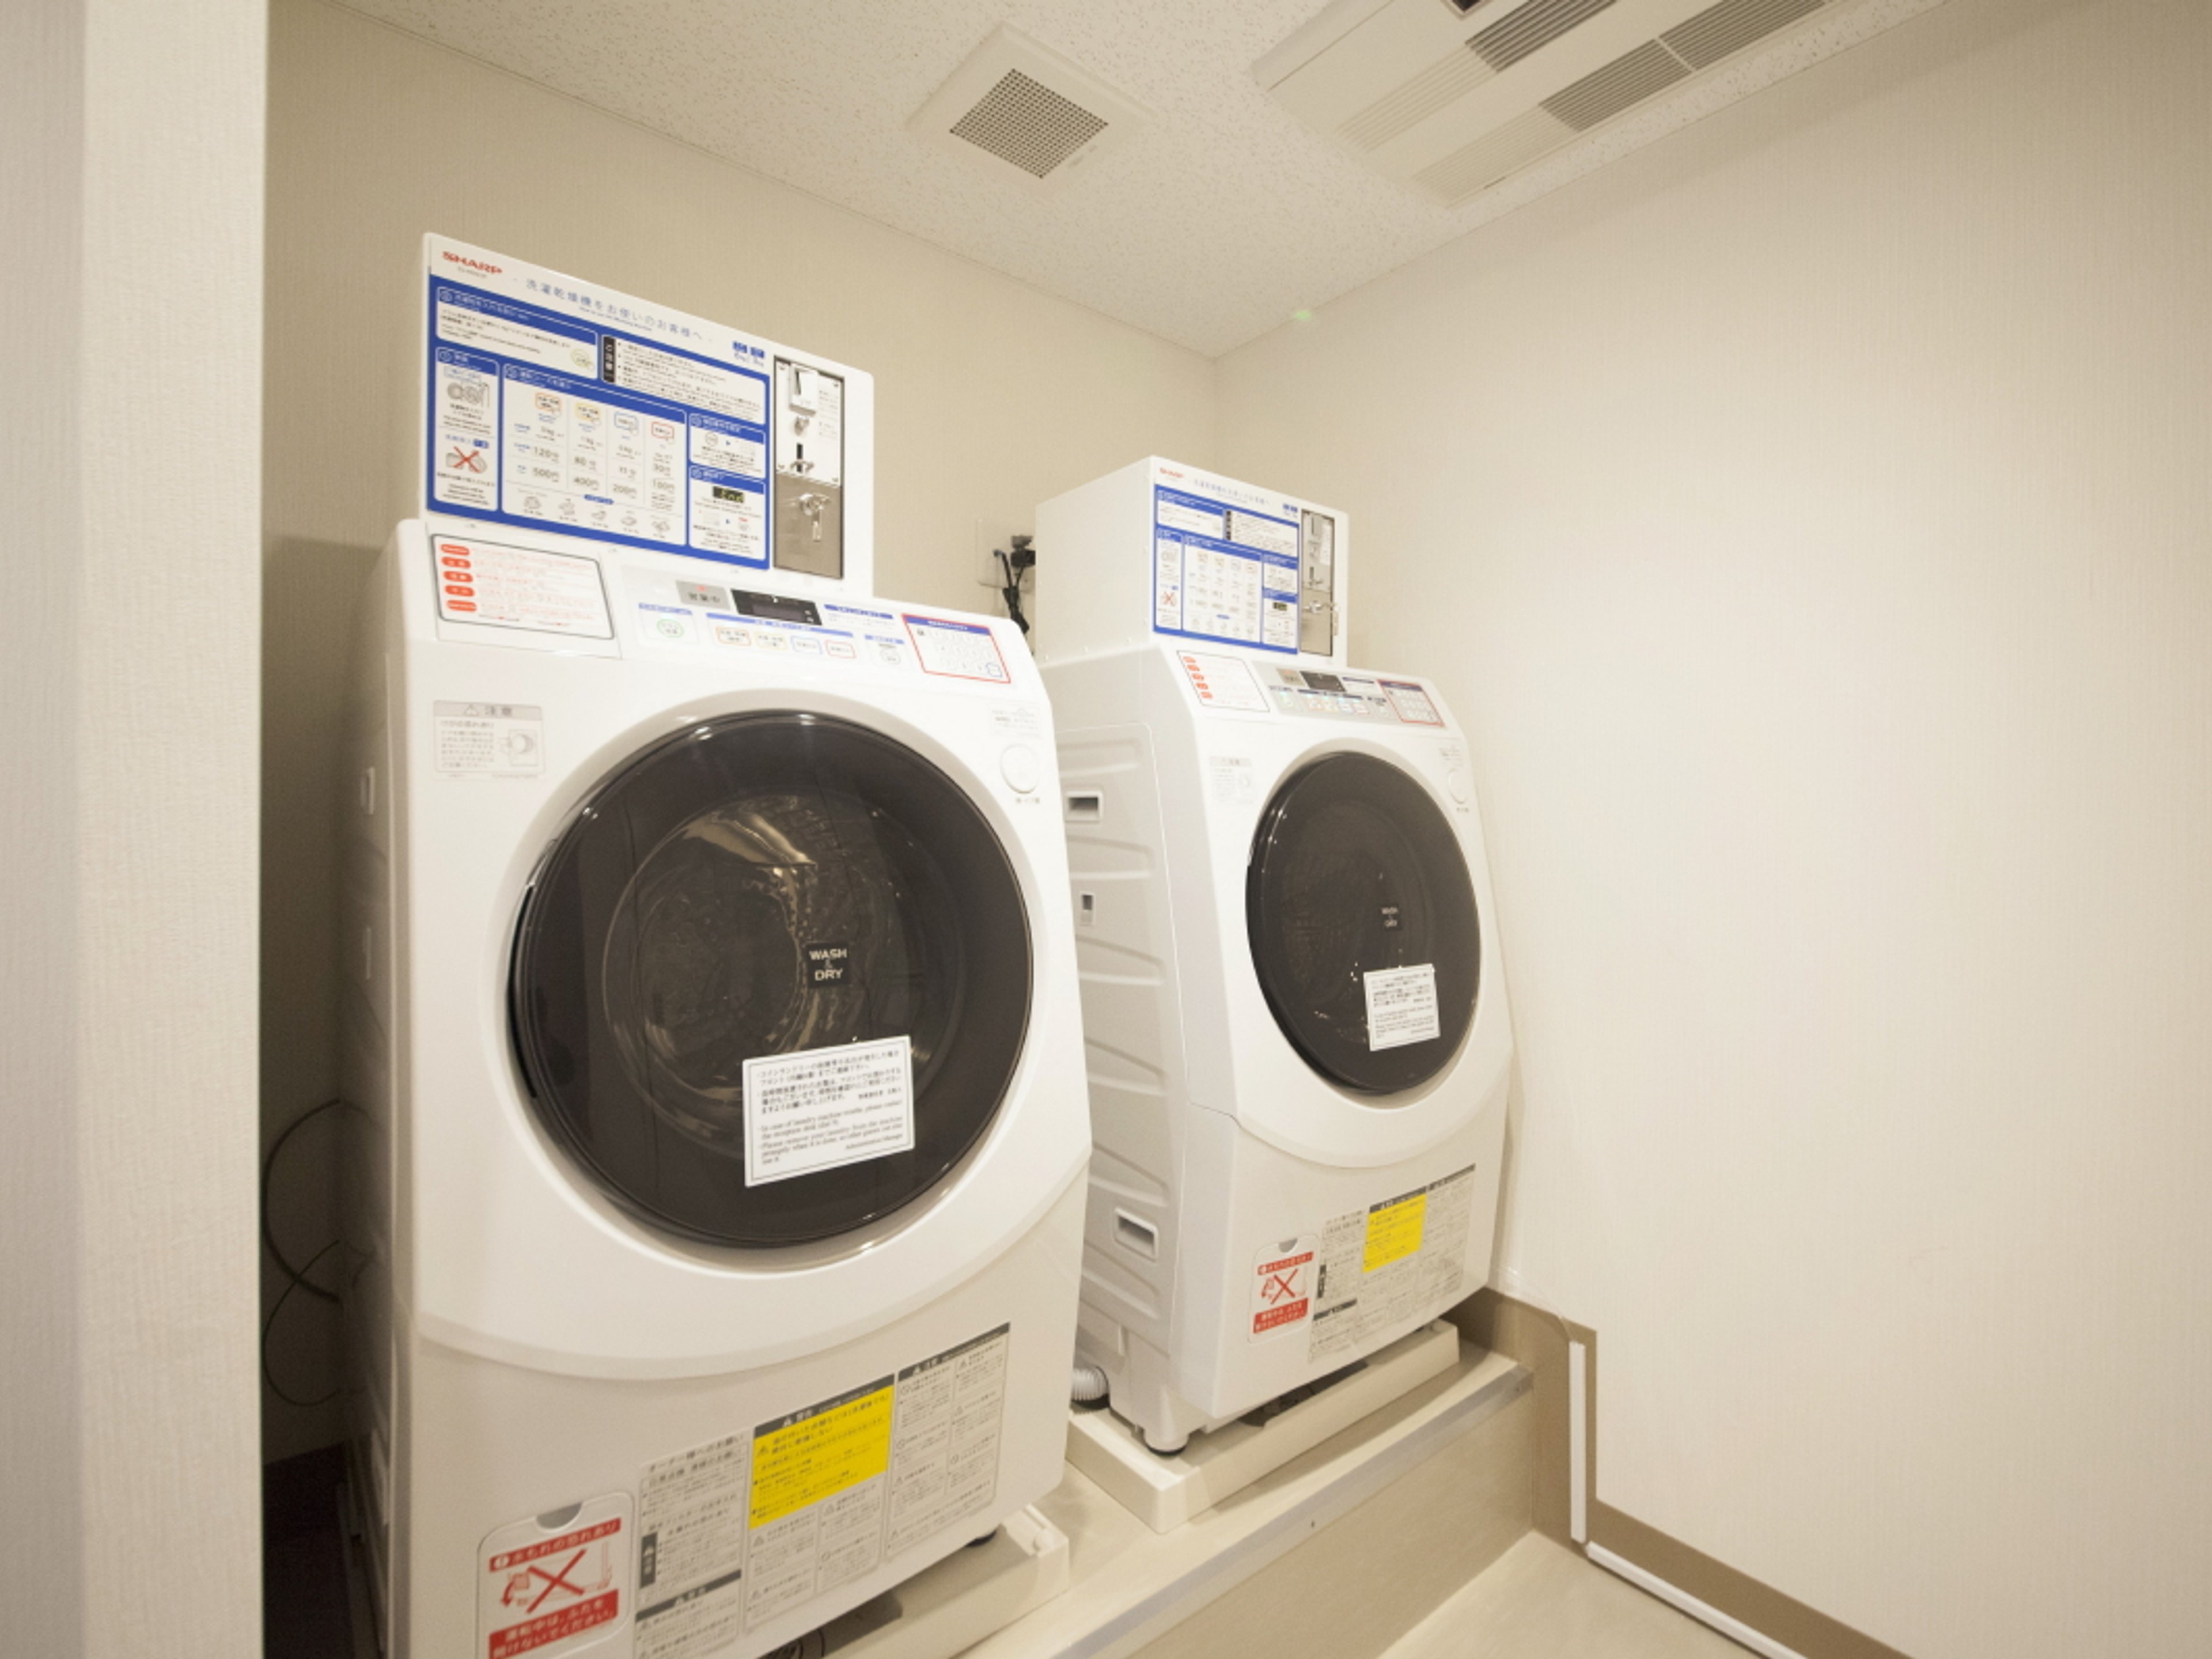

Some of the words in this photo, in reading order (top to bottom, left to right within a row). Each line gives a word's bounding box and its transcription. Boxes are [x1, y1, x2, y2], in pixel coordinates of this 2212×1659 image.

[442, 251, 503, 274] SHARP
[809, 949, 847, 961] WASH
[815, 968, 843, 981] DRY
